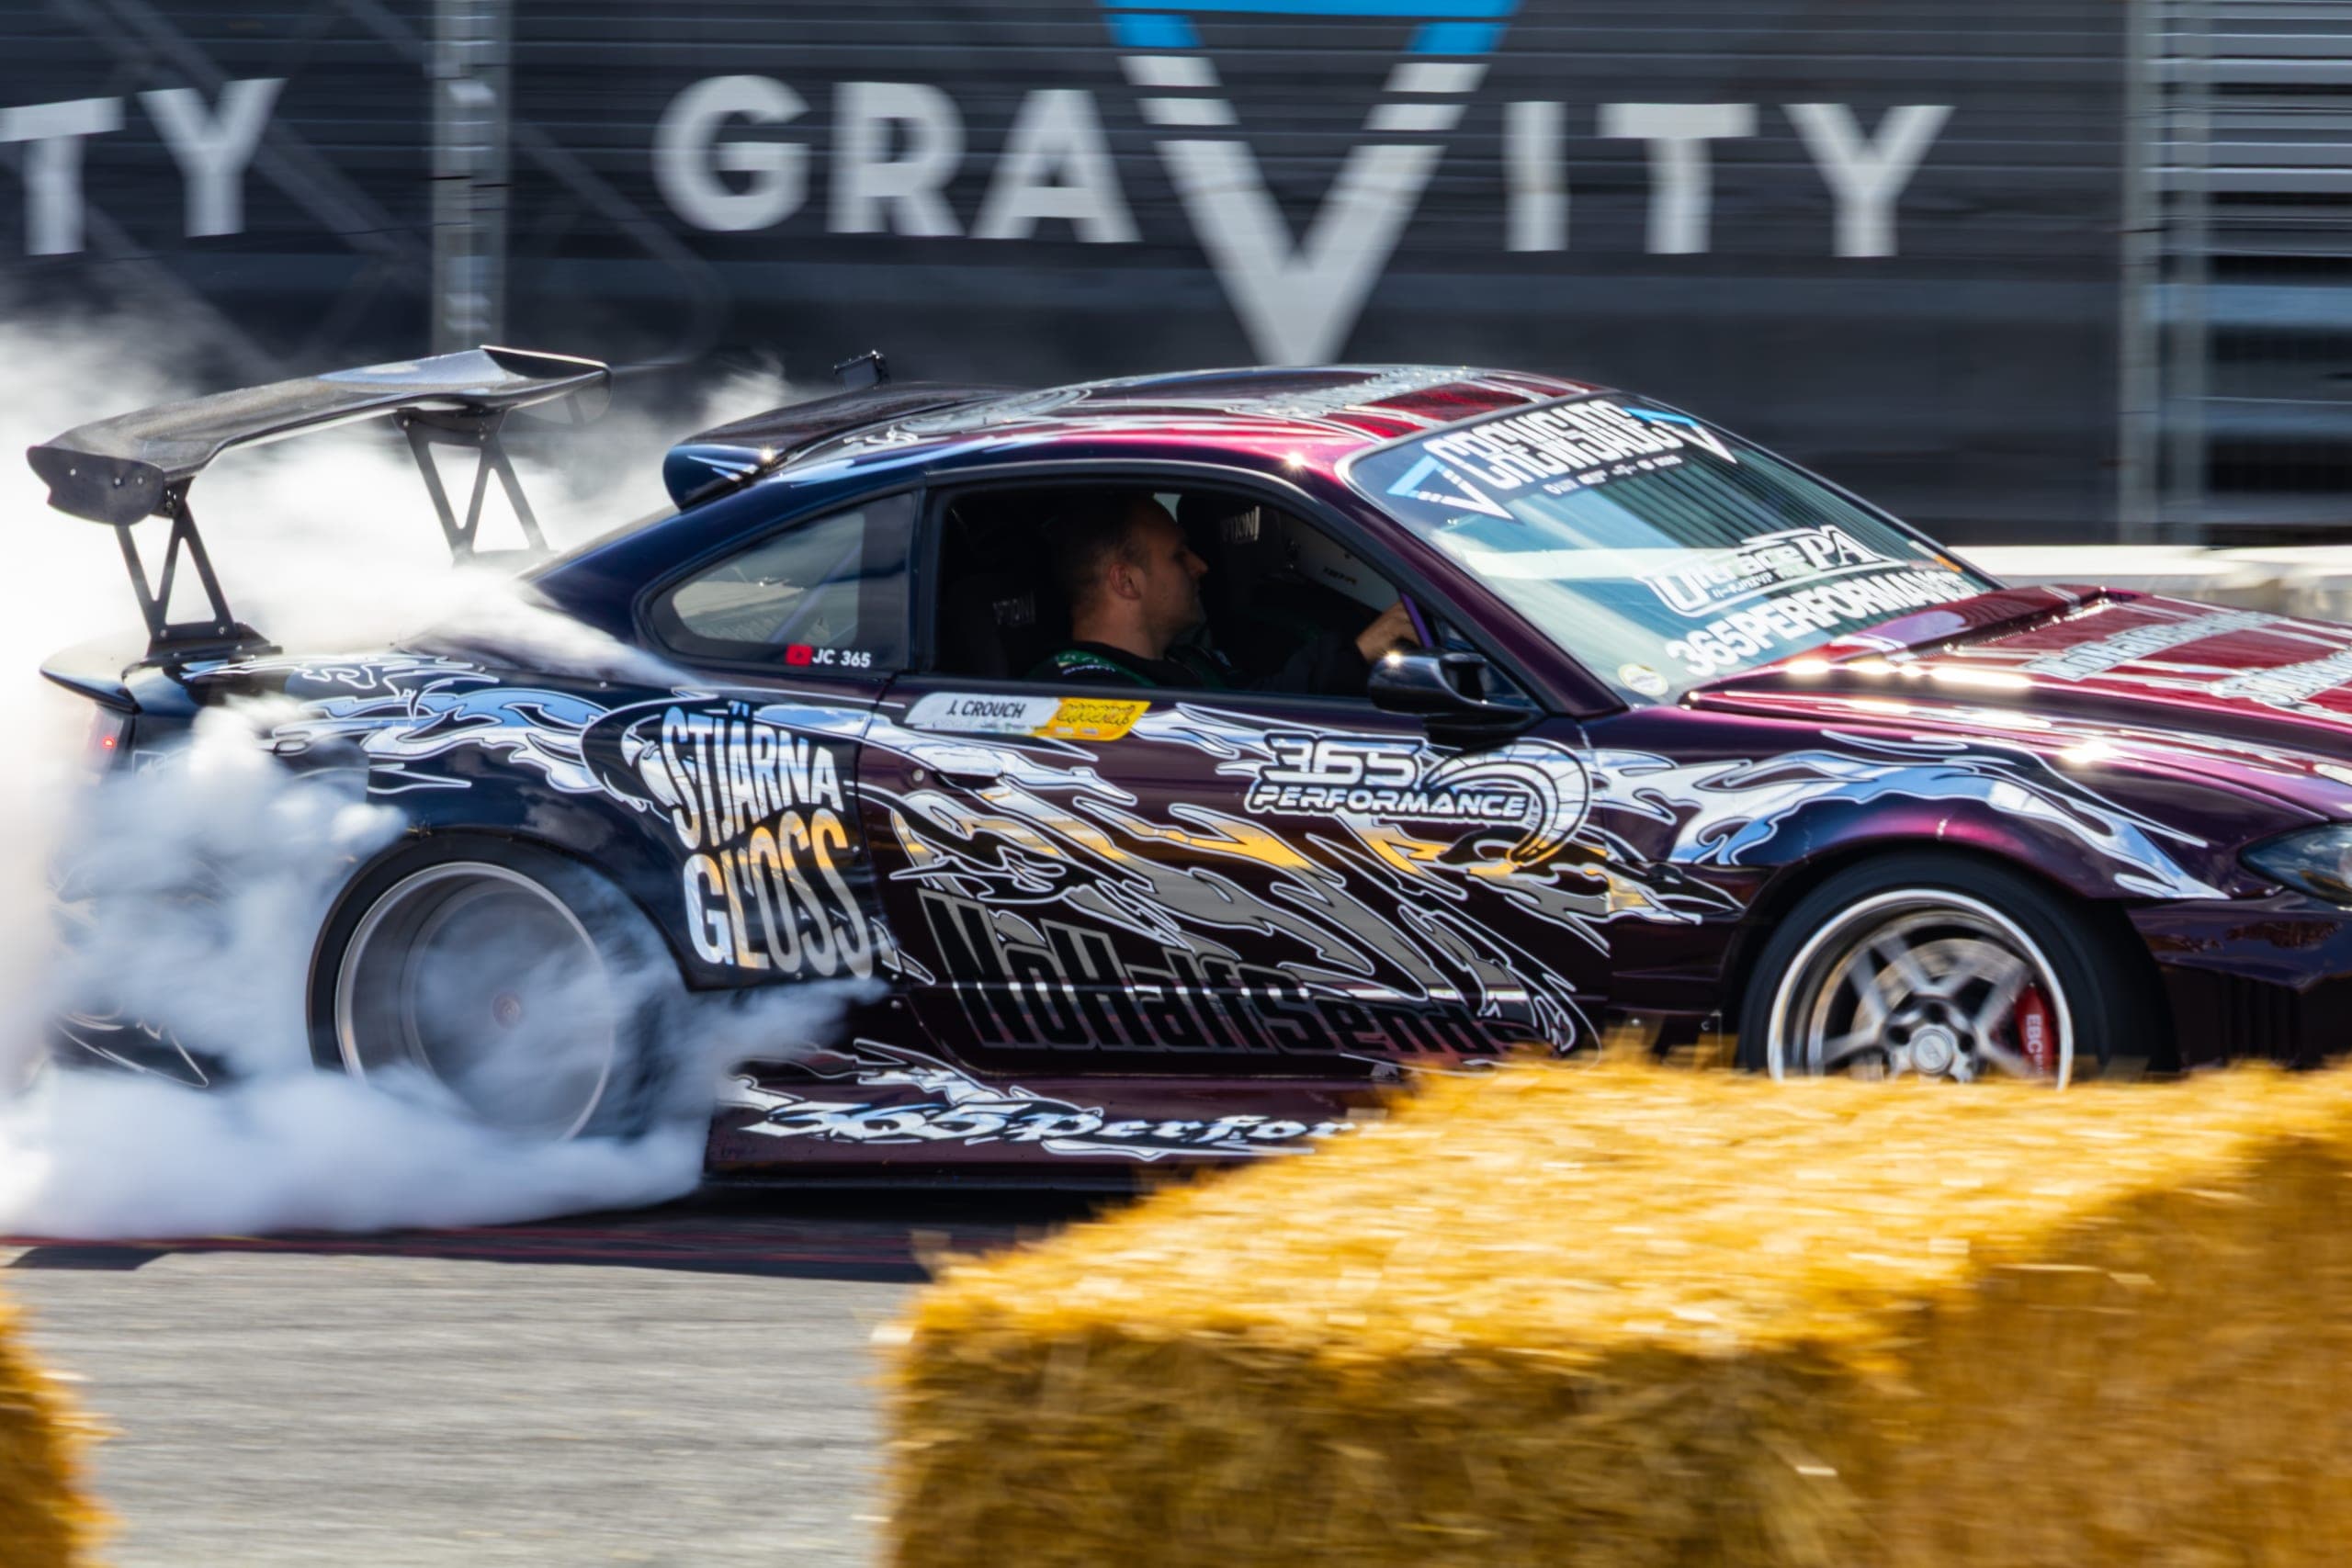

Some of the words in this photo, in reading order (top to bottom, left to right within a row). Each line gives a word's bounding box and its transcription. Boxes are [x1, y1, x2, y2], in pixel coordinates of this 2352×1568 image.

[651, 0, 1956, 367] GRAVITY
[1655, 543, 1805, 610] Ultrace
[1666, 567, 1987, 677] 365PERFORMANCE
[811, 649, 836, 664] JC
[840, 650, 872, 668] 365
[961, 700, 1026, 719] CROUCH
[662, 700, 844, 850] STJÄRNA
[1264, 737, 1419, 786] 365
[1253, 784, 1531, 818] PERFORMANCE
[684, 810, 872, 979] GLOSS
[2025, 1013, 2044, 1055] EBC
